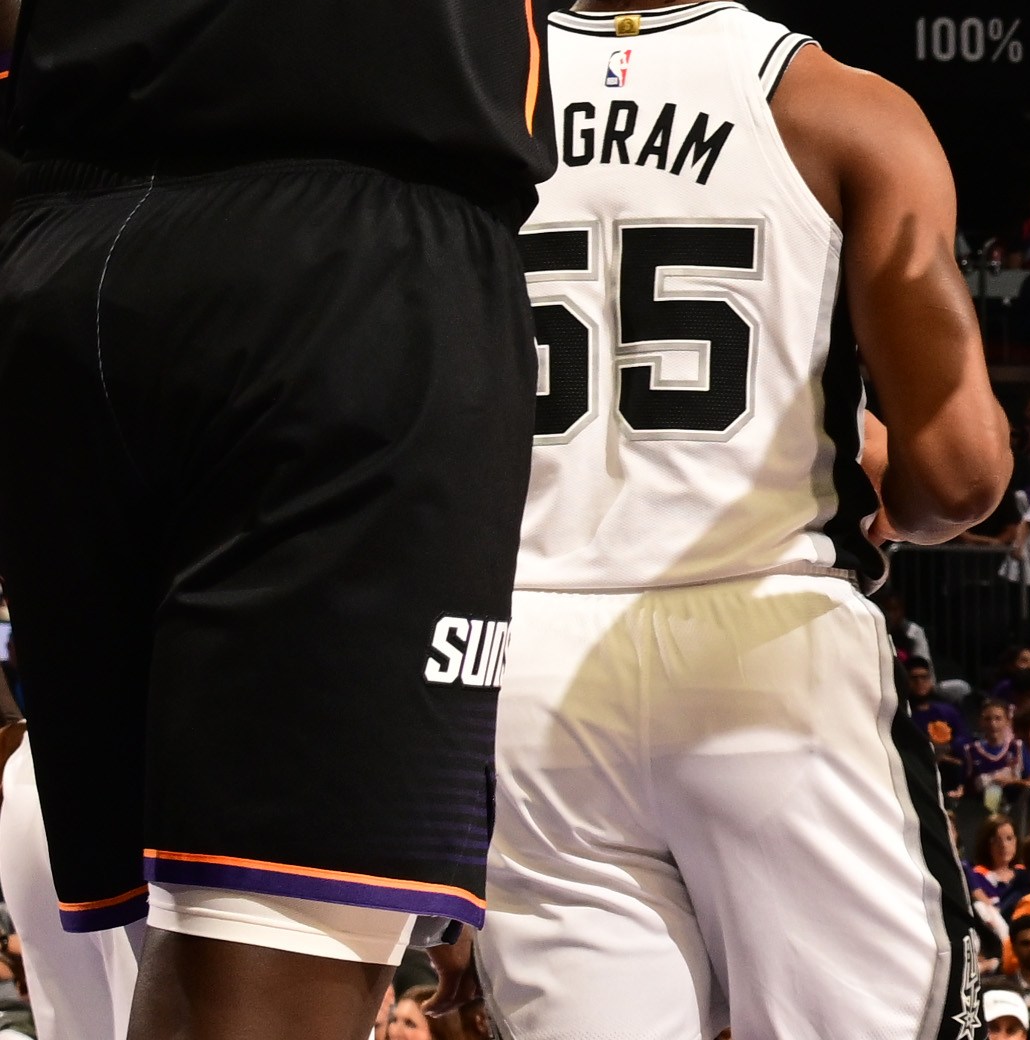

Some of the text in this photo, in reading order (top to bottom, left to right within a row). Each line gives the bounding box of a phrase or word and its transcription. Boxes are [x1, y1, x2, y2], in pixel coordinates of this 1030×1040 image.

[915, 16, 1024, 65] 100%
[563, 100, 735, 186] GRAM
[424, 616, 512, 688] SUN
